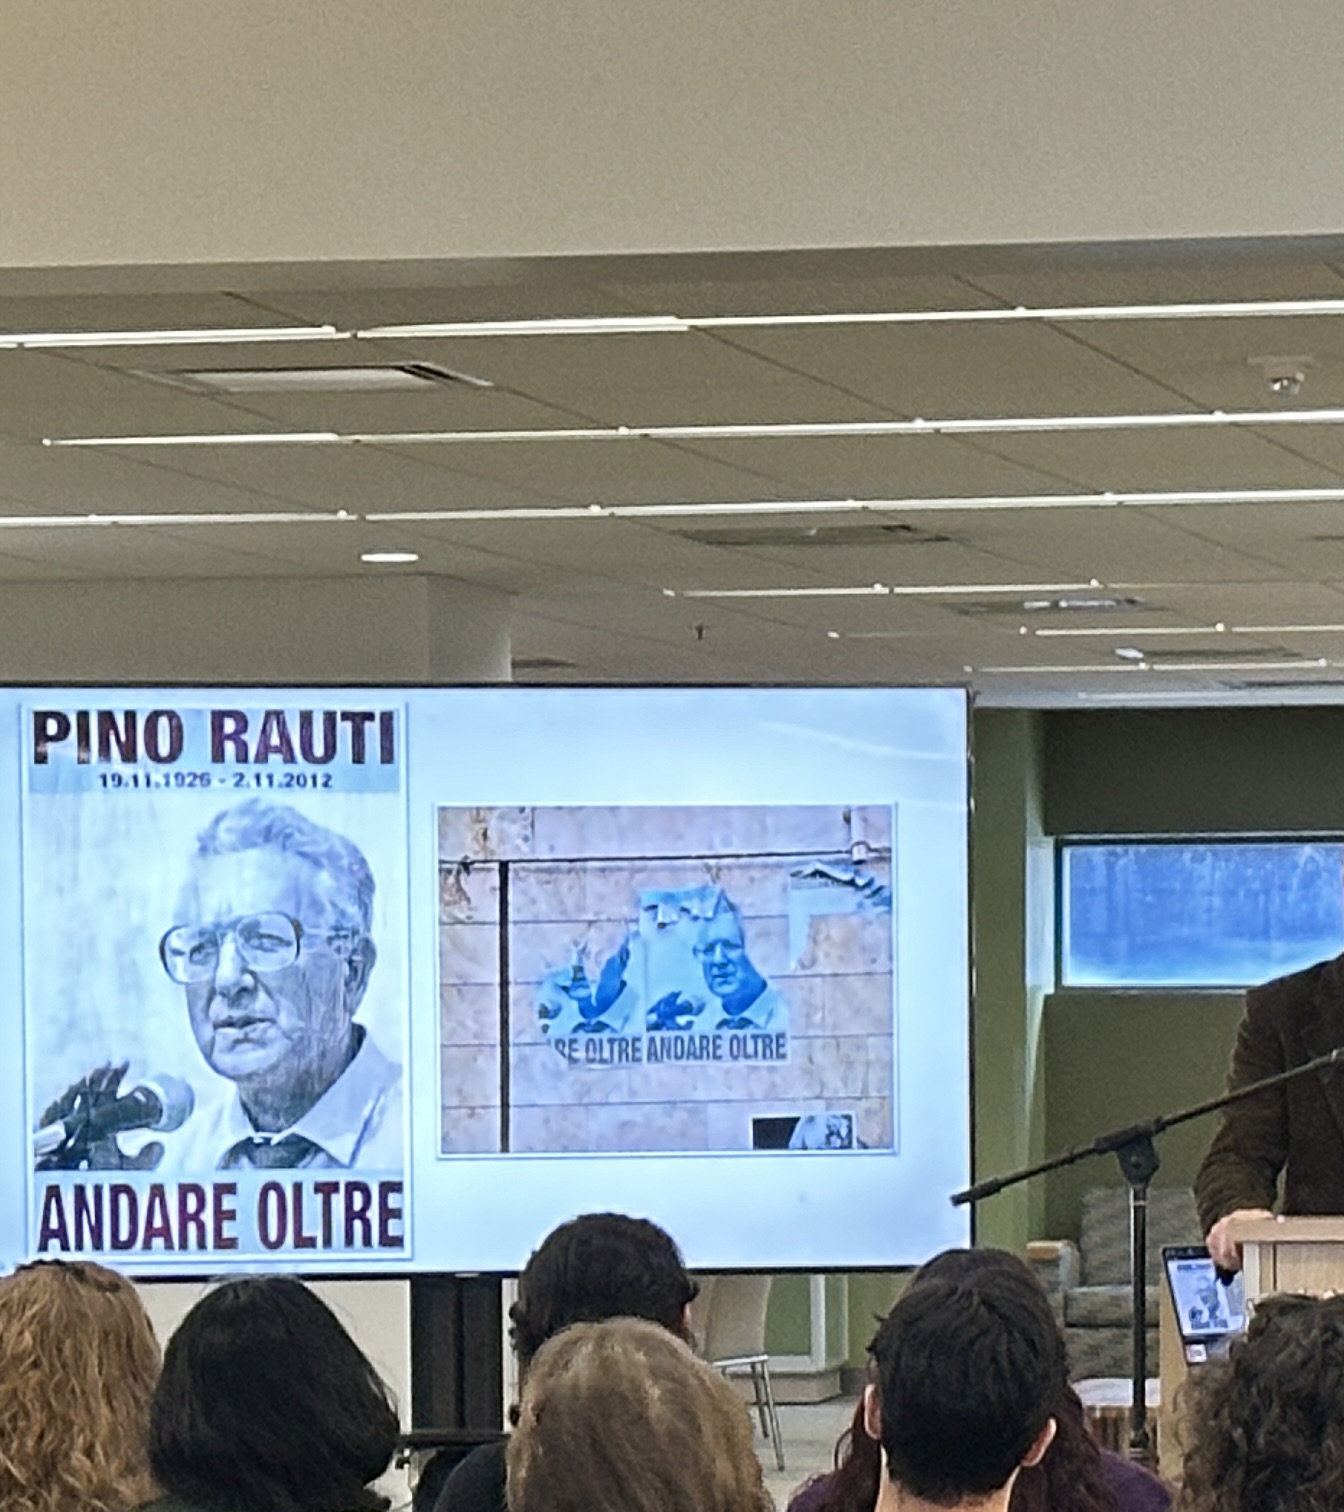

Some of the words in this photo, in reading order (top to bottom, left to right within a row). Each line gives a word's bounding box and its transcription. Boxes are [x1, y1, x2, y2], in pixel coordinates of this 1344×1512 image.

[32, 709, 185, 765] PINO
[210, 709, 395, 765] RAUTI
[232, 772, 334, 789] 2.11.2012
[584, 1037, 642, 1064] OLTRE
[647, 1034, 723, 1063] ANDARE
[729, 1032, 787, 1060] OLTRE
[37, 1181, 240, 1253] ANDARE
[258, 1180, 404, 1251] OLTRE
